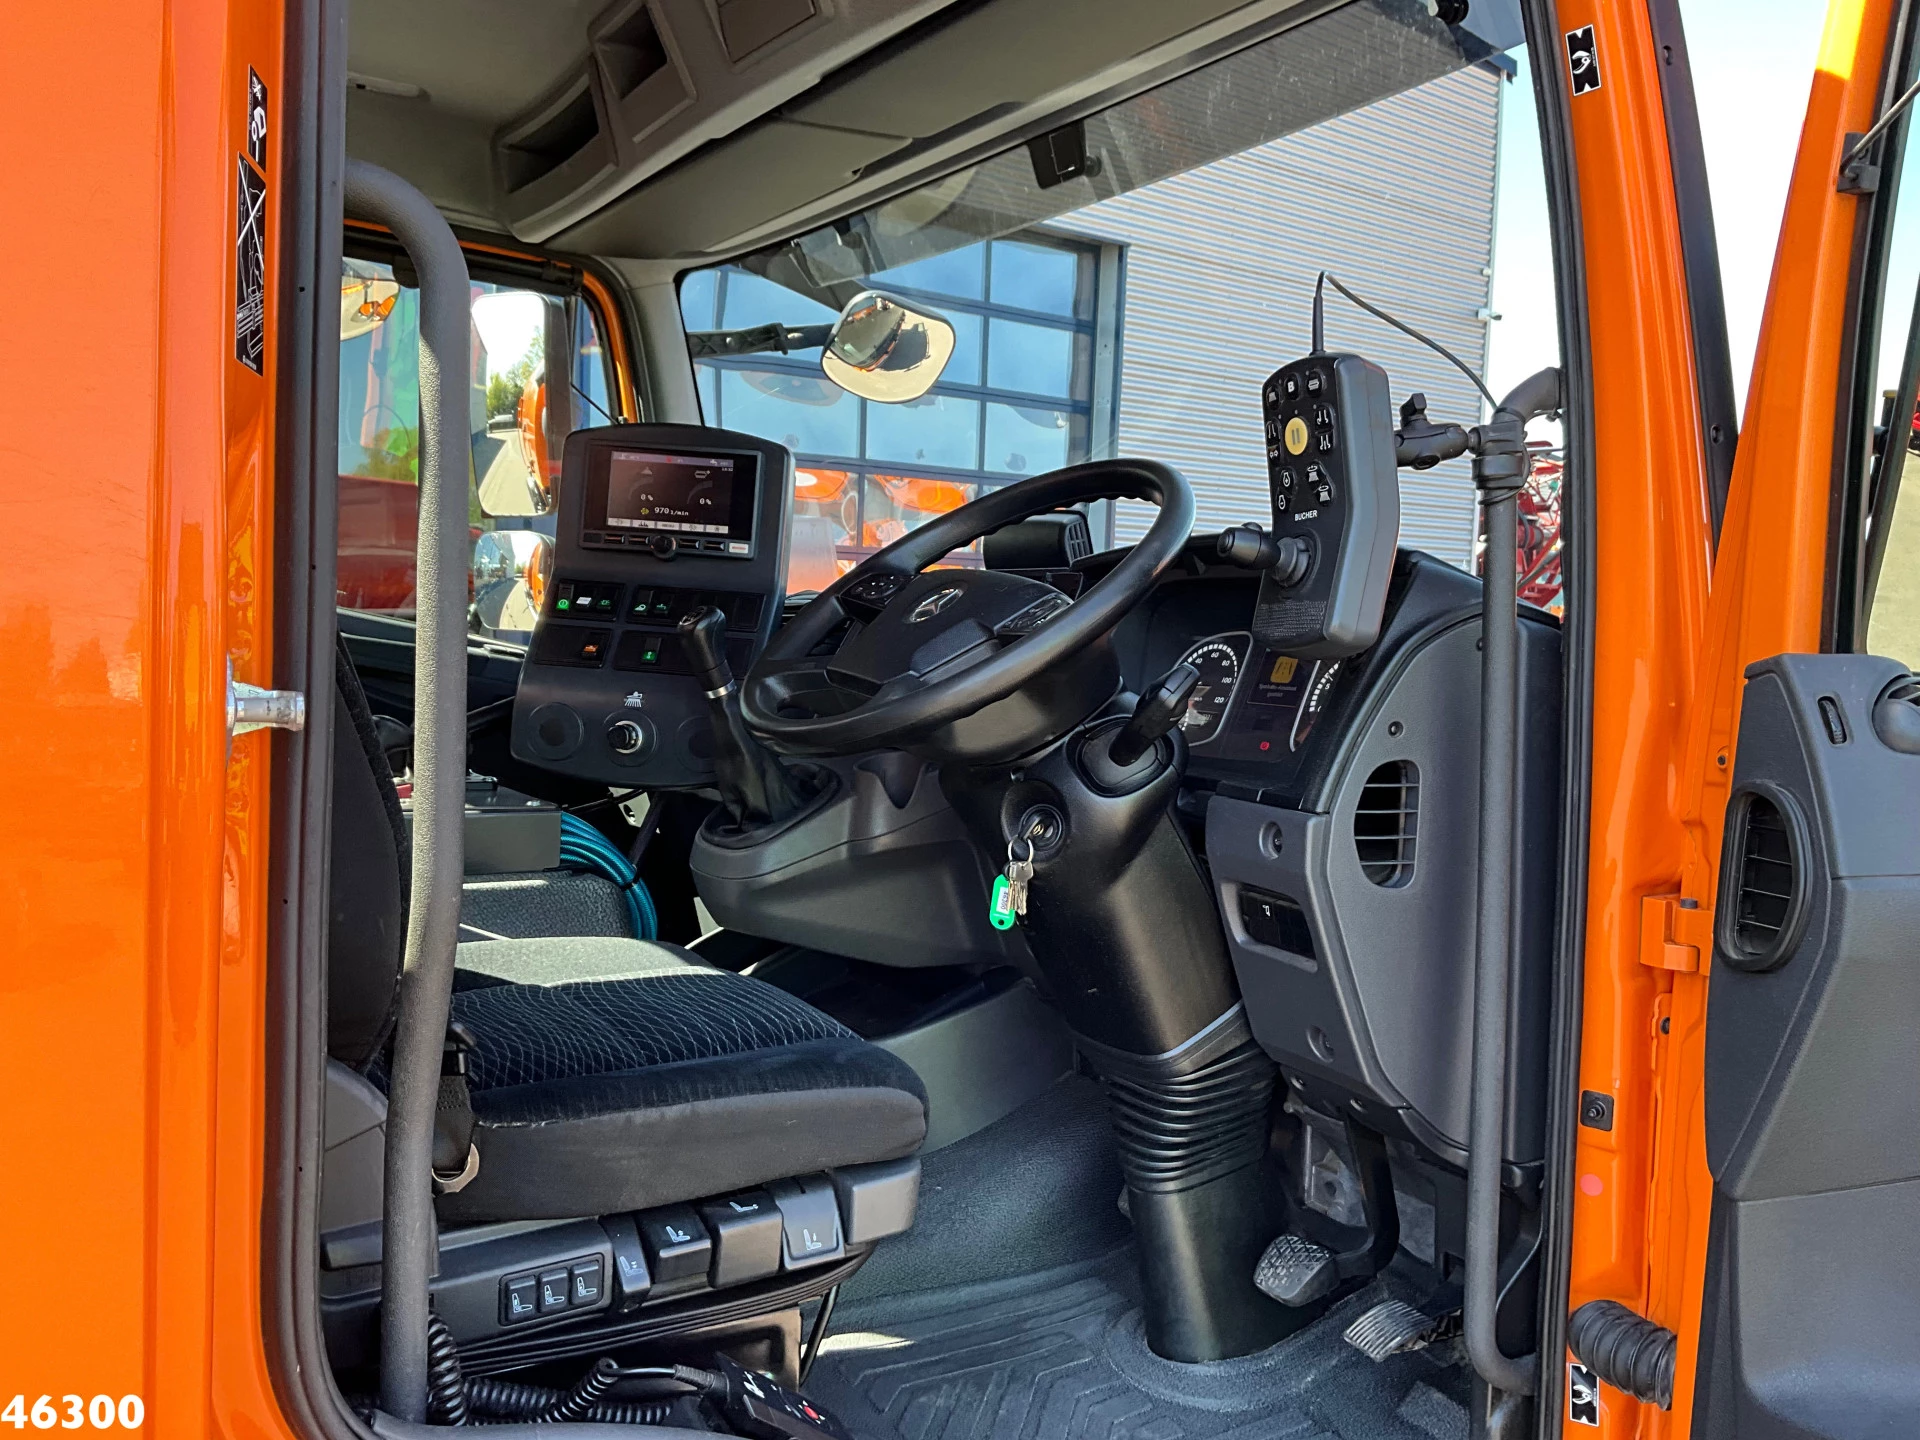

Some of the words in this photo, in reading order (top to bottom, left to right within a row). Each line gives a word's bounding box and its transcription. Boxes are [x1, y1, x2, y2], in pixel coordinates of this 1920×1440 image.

[654, 507, 670, 515] 970
[1294, 509, 1318, 521] BUCHER
[1221, 659, 1231, 667] 80
